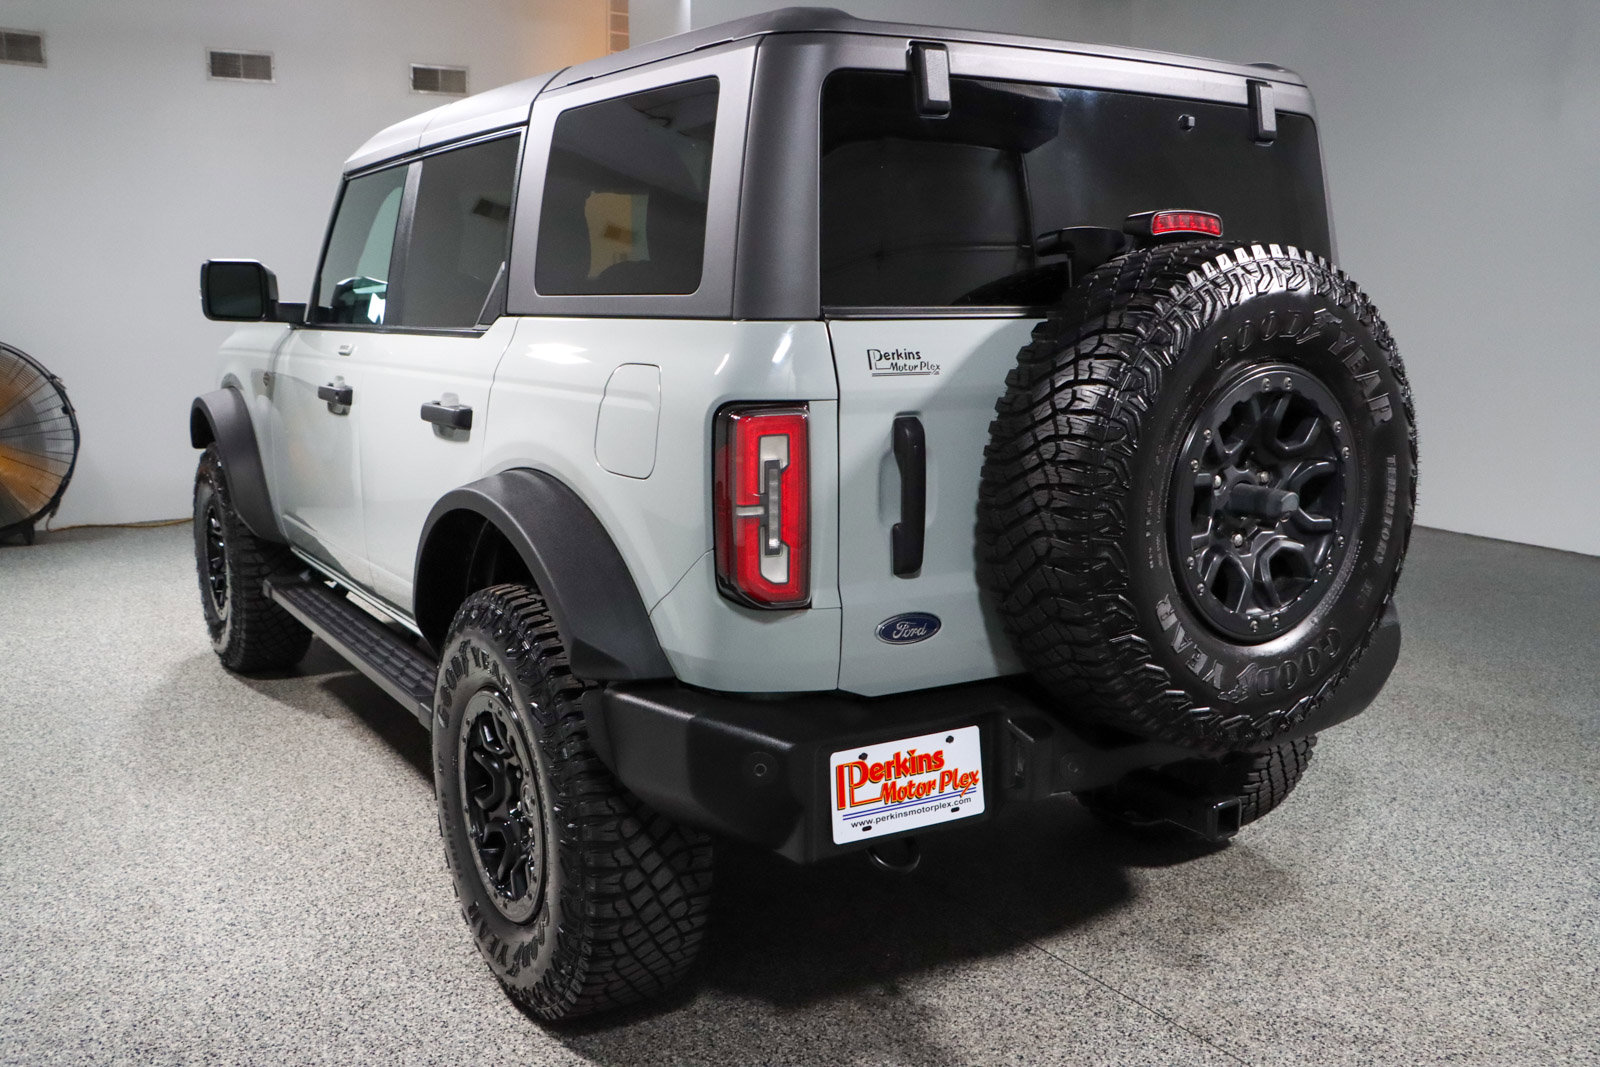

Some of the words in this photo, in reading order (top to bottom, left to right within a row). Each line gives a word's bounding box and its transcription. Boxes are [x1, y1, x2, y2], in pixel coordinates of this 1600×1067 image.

[866, 348, 922, 371] Perkins
[920, 361, 941, 375] Plex
[892, 621, 928, 639] Ford
[836, 749, 946, 811] Perkins
[879, 778, 937, 805] Motor
[939, 767, 981, 799] Plex
[851, 796, 972, 829] www.perkinsmotorplex.com
